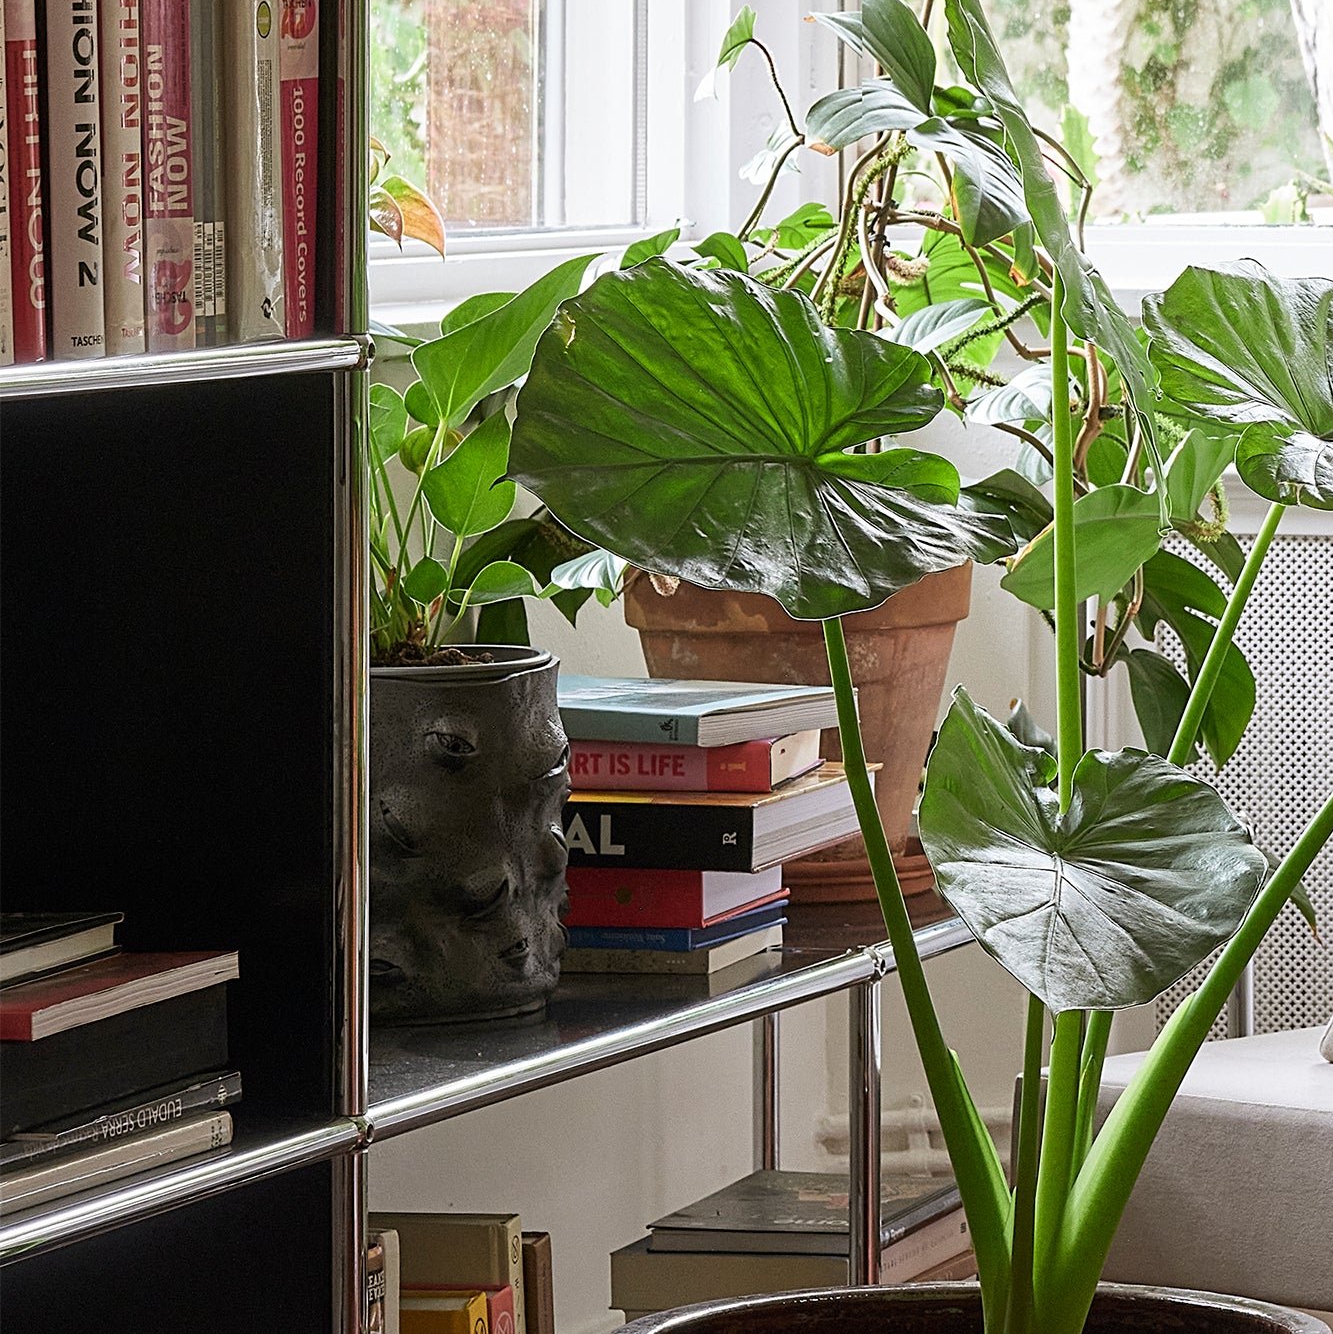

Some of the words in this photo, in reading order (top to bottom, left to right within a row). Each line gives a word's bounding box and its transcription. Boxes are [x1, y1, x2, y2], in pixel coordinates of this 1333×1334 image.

[147, 44, 165, 212] FASHION
[293, 86, 305, 146] 1000
[74, 123, 99, 246] NOW
[166, 115, 189, 211] NOW
[294, 151, 308, 236] Record
[120, 152, 142, 285] NOW
[78, 260, 98, 287] 2
[296, 242, 308, 323] Covers
[608, 753, 632, 776] IS
[637, 754, 686, 777] LIFE
[722, 831, 738, 846] R
[102, 1112, 136, 1140] SERRA
[137, 1098, 183, 1129] EUDALD
